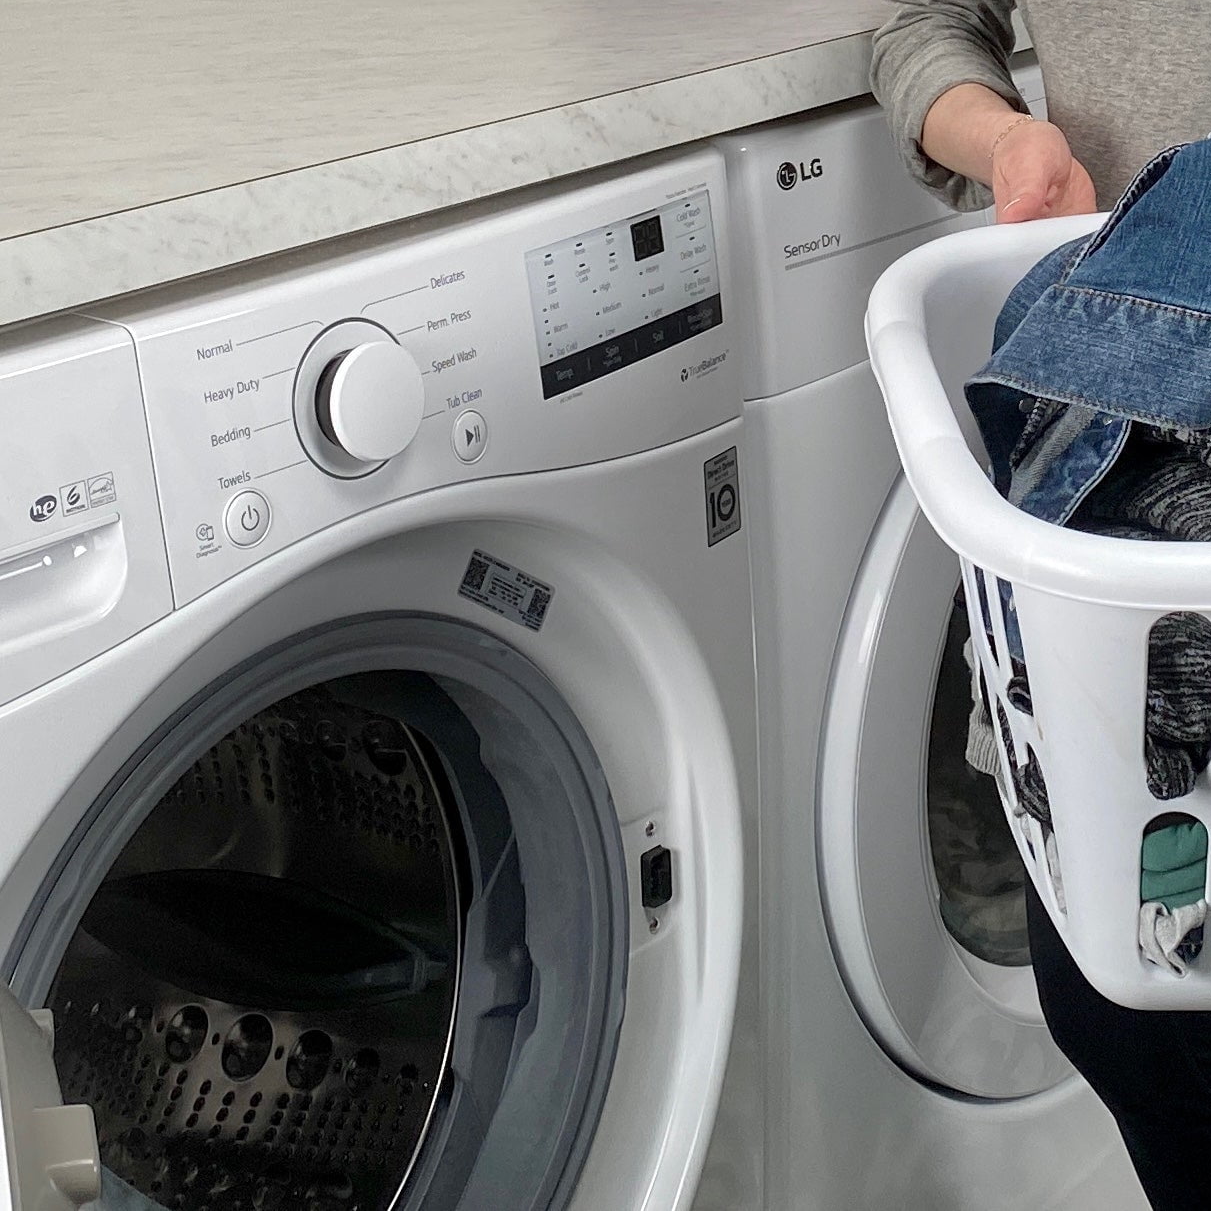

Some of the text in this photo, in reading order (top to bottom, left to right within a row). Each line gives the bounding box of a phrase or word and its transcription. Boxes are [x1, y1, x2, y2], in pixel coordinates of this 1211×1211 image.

[800, 158, 823, 181] LG
[430, 270, 466, 290] Delicates
[427, 309, 472, 333] Perm. Press
[196, 339, 234, 360] Normal
[431, 347, 477, 374] Speed Wash
[203, 379, 260, 404] Heavy Duty
[446, 388, 483, 410] Tub Clean
[210, 426, 251, 447] Bedding
[217, 470, 251, 490] Towels
